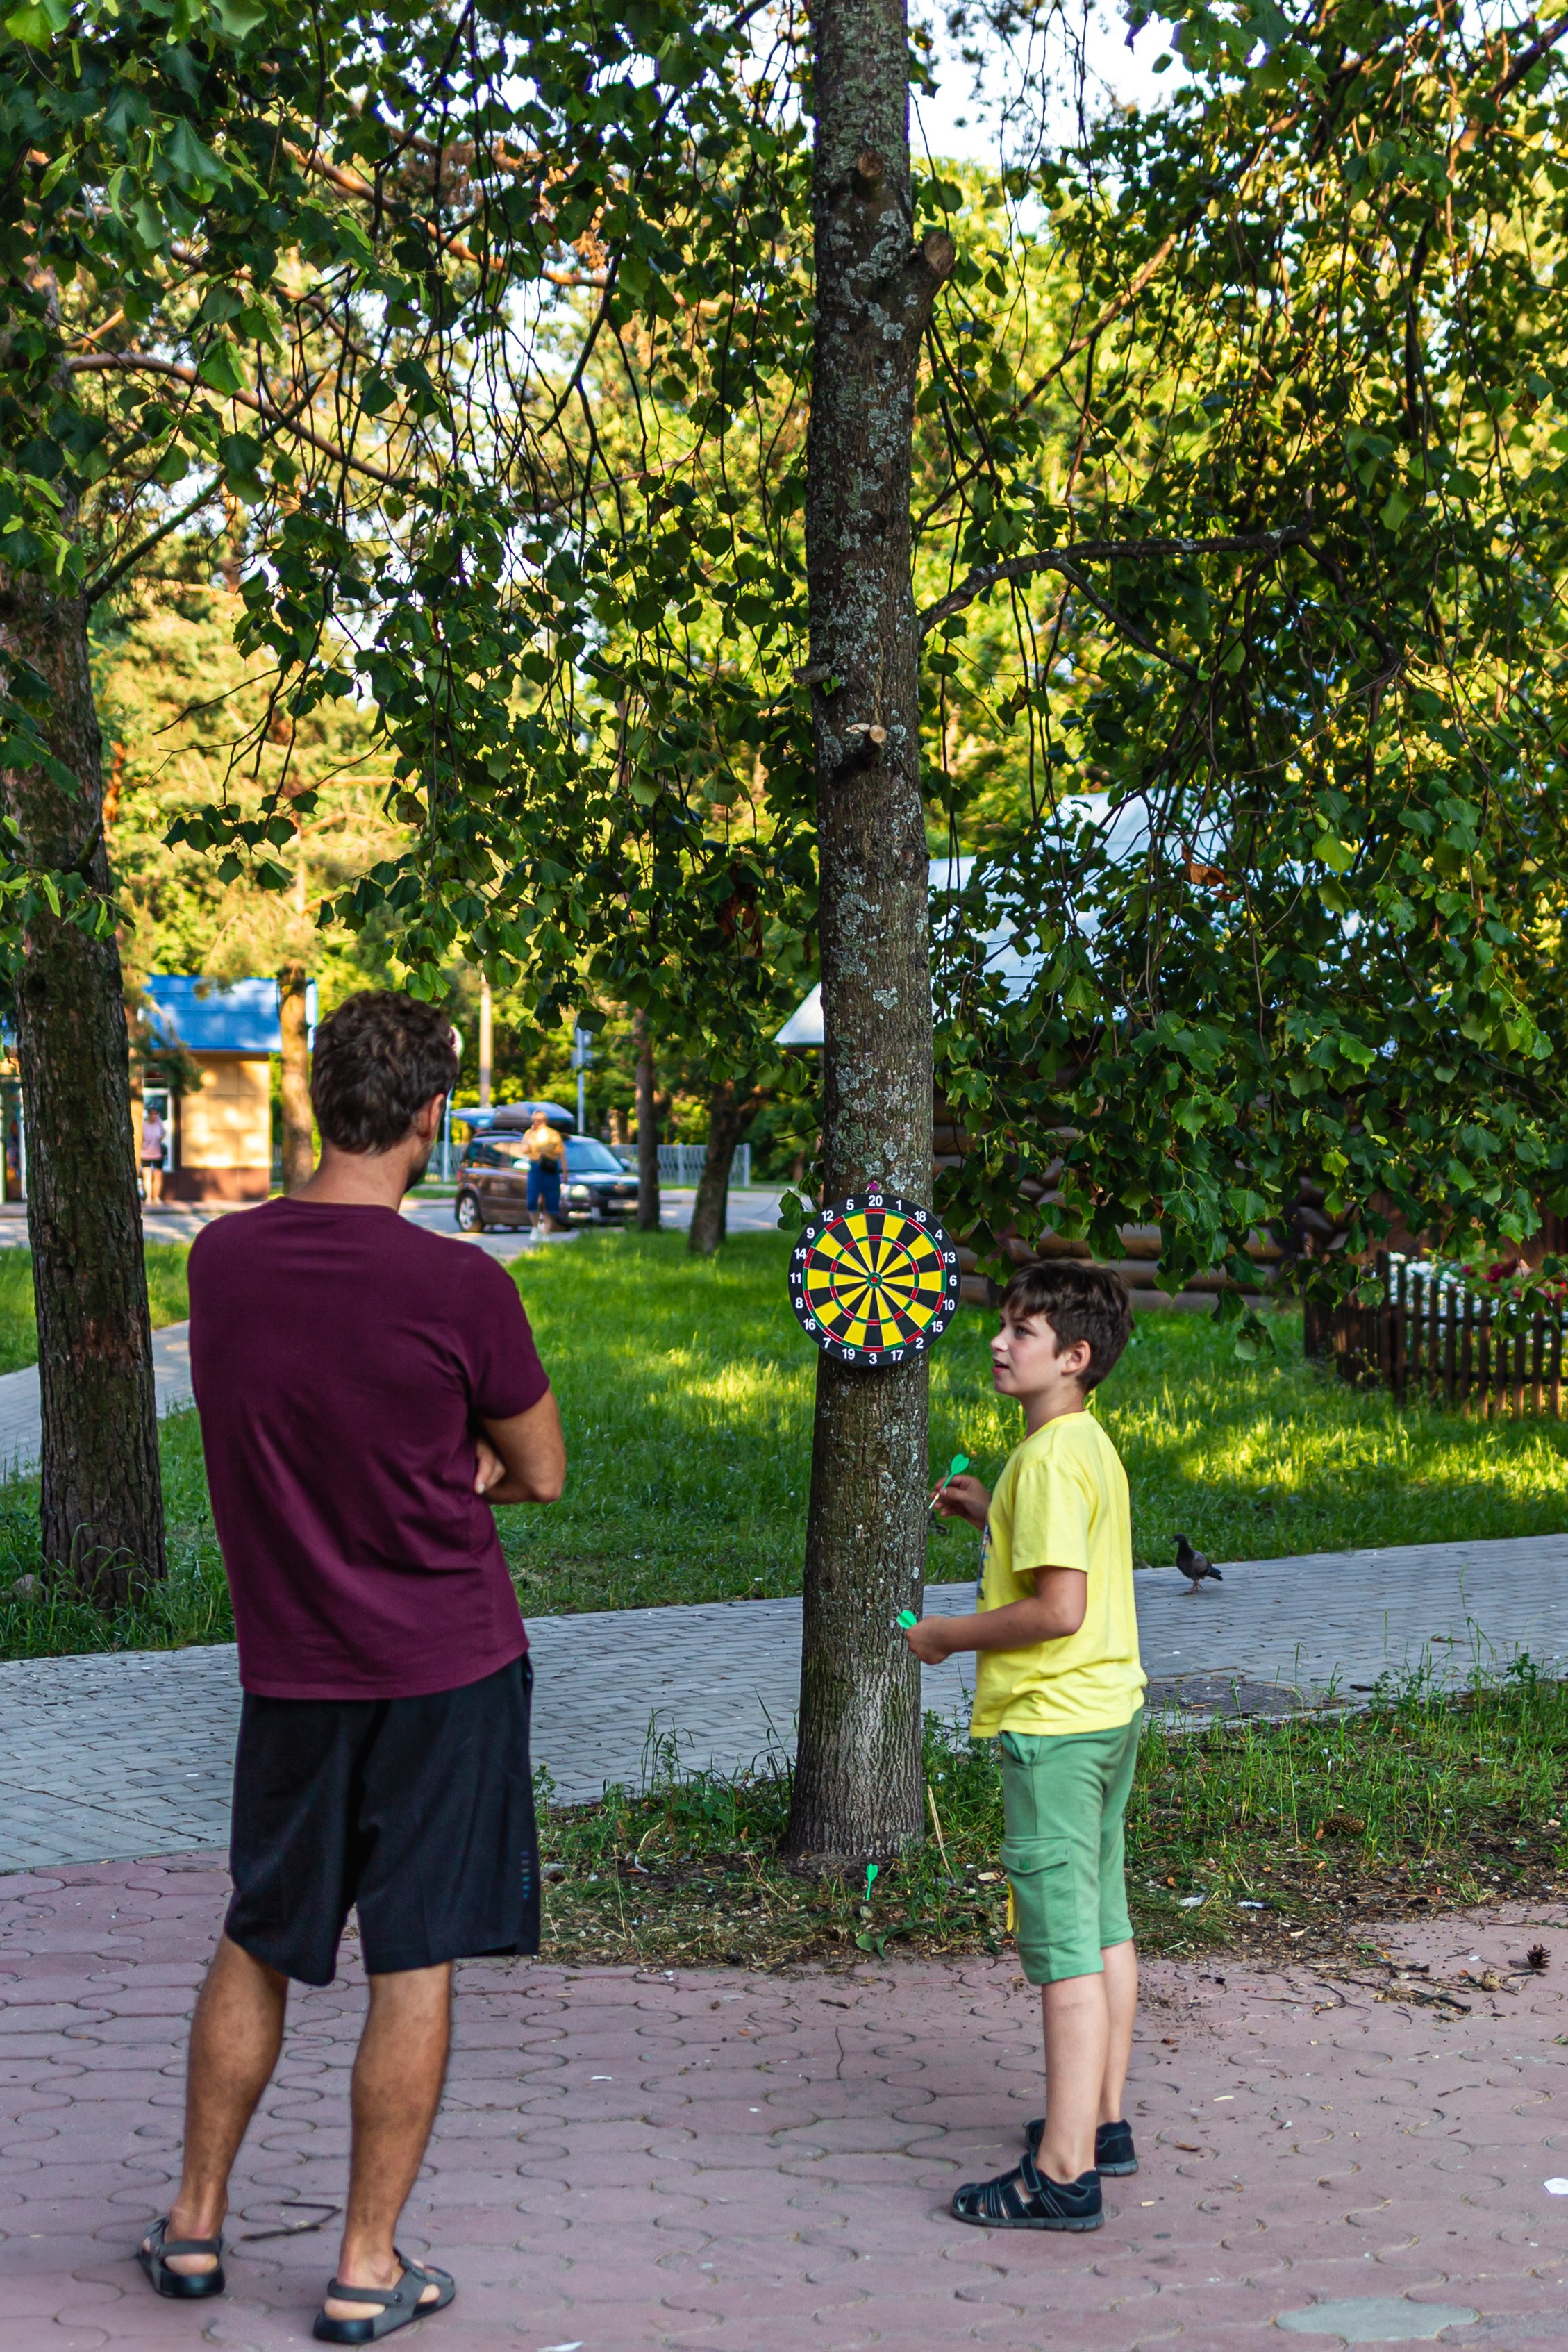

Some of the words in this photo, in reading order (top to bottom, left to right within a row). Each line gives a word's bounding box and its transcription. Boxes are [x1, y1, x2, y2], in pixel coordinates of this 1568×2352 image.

[846, 1199, 854, 1210] 5
[869, 1195, 883, 1206] 20
[896, 1200, 901, 1210] 1
[822, 1210, 833, 1221] 12
[914, 1211, 926, 1222] 18
[807, 1228, 815, 1239] 9
[935, 1229, 942, 1240] 4
[794, 1248, 807, 1259] 14
[944, 1252, 956, 1263] 13
[790, 1273, 801, 1283] 11
[949, 1275, 957, 1286] 6
[796, 1297, 803, 1308] 8
[944, 1299, 955, 1310] 10
[803, 1319, 816, 1330] 16
[932, 1321, 943, 1332] 15
[824, 1338, 831, 1348] 7
[916, 1337, 924, 1349] 2
[842, 1348, 855, 1360] 19
[869, 1353, 877, 1364] 3
[891, 1350, 903, 1360] 17
